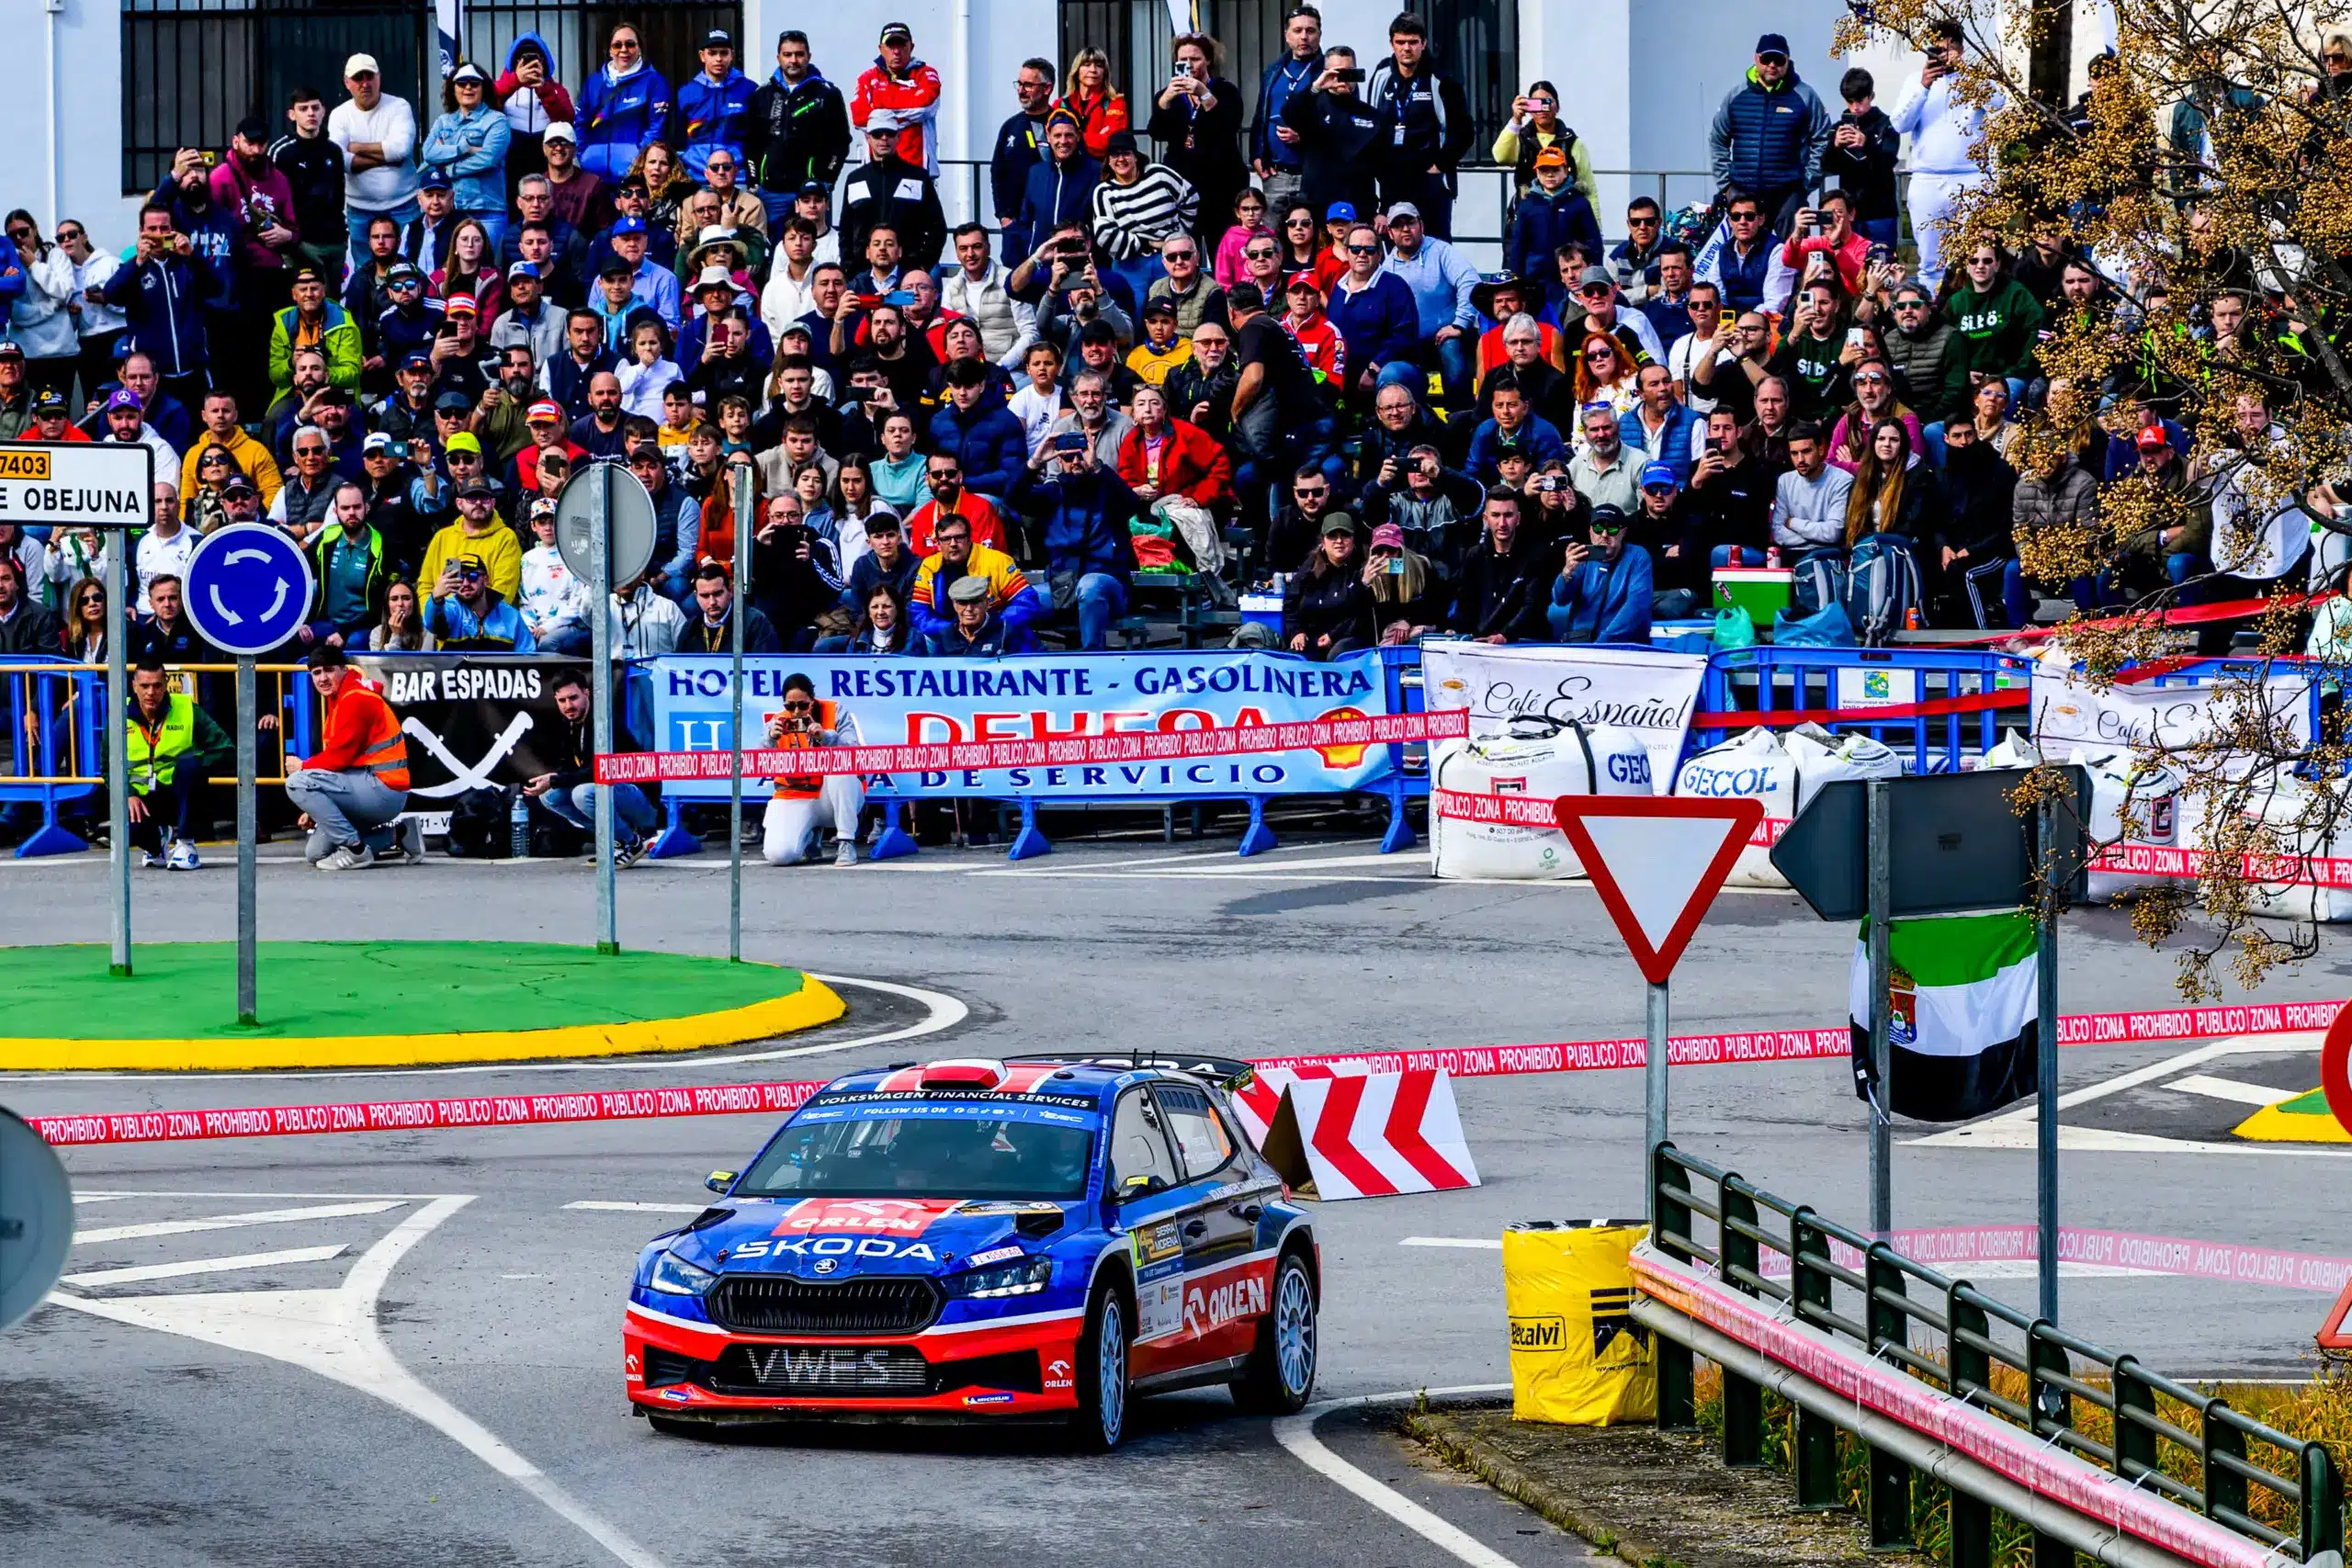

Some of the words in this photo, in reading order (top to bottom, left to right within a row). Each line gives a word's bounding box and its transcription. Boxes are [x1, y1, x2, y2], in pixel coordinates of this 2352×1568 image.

[24, 488, 141, 513] OBEJUNA
[390, 671, 436, 703] BAR
[442, 669, 542, 701] ESPADAS
[831, 669, 1092, 698] RESTAURANTE
[1135, 664, 1374, 697] GASOLINERA
[1485, 682, 1542, 717] Café
[1544, 676, 1691, 729] Español
[600, 757, 633, 779] PUBLICO
[637, 756, 655, 777] ZONA
[660, 755, 697, 775] PROHIBIDO
[701, 753, 731, 775] PUBLICO
[741, 753, 754, 774] ONA
[758, 752, 796, 773] PROHIBIDO
[799, 751, 830, 773] PUBLICO
[832, 750, 852, 772] ZONA
[855, 750, 893, 770] PROHIBIDO
[897, 747, 926, 769] PUBLICO
[930, 746, 948, 767] ZONA
[953, 744, 989, 766] PROHIBIDO
[993, 742, 1023, 764] PUBLICO
[1026, 741, 1045, 763] ZONA
[1049, 739, 1086, 761] PROHIBIDO
[1090, 738, 1119, 759] PUBLICO
[1122, 737, 1140, 758] ZONA
[1144, 734, 1182, 755] PROHIBIDO
[1185, 732, 1214, 753] PUBLICO
[1217, 731, 1236, 751] ZONA
[1239, 728, 1276, 750] PROHIBIDO
[1280, 726, 1308, 747] PUBLICO
[1312, 725, 1330, 744] ZONA
[1334, 720, 1371, 742] PROHIBIDO
[1374, 718, 1403, 739] PUBLICO
[1407, 717, 1425, 738] ZONA
[1428, 714, 1464, 735] PROHIBIDO
[921, 771, 983, 787] DE
[1010, 764, 1285, 787] SERVICIO
[1608, 753, 1651, 784] GEC
[1684, 765, 1778, 796] GECOL
[1441, 795, 1470, 817] PUBLICO
[1475, 797, 1501, 819] ZONA
[2155, 851, 2184, 873] ZONA
[2057, 1021, 2088, 1042] BLICO
[2095, 1019, 2126, 1040] ZONA
[2131, 1014, 2191, 1037] PROHIBIDO
[2198, 1010, 2245, 1032] PUBLICO
[2250, 1008, 2283, 1031] ZONA
[1462, 1050, 1495, 1073] ZONA
[1499, 1046, 1561, 1071] PROHIBIDO
[1567, 1043, 1617, 1067] PUBLICO
[1621, 1042, 1645, 1065] ZON
[1668, 1039, 1720, 1063] ROHIBIDO
[1724, 1035, 1775, 1058] PUBLICO
[1781, 1032, 1812, 1055] ZONA
[1816, 1030, 1851, 1054] PROHI
[41, 1118, 106, 1142] PROHIBIDO
[111, 1114, 162, 1138] PUBLICO
[168, 1114, 201, 1136] ZONA
[206, 1111, 270, 1134] PROHIBIDO
[276, 1108, 327, 1131] PUBLICO
[332, 1106, 365, 1128] ZONA
[369, 1103, 434, 1125] PROHIBIDO
[438, 1100, 490, 1122] PUBLICO
[495, 1099, 528, 1121] ZONA
[533, 1096, 597, 1118] PROHIBIDO
[603, 1092, 652, 1115] PUBLICO
[659, 1091, 691, 1112] ZONA
[695, 1088, 759, 1110] PROHIBIDO
[820, 1092, 926, 1105] VOLKSWAGEN
[930, 1091, 1012, 1100] FINANCIAL
[1017, 1093, 1090, 1108] SERVICES
[789, 1217, 921, 1230] ORLEN
[1156, 1223, 1177, 1237] SIERRA
[1155, 1235, 1179, 1251] MORENA
[1209, 1277, 1266, 1325] ORLEN
[747, 1348, 889, 1384] VWFS
[1045, 1380, 1073, 1388] ORLEN
